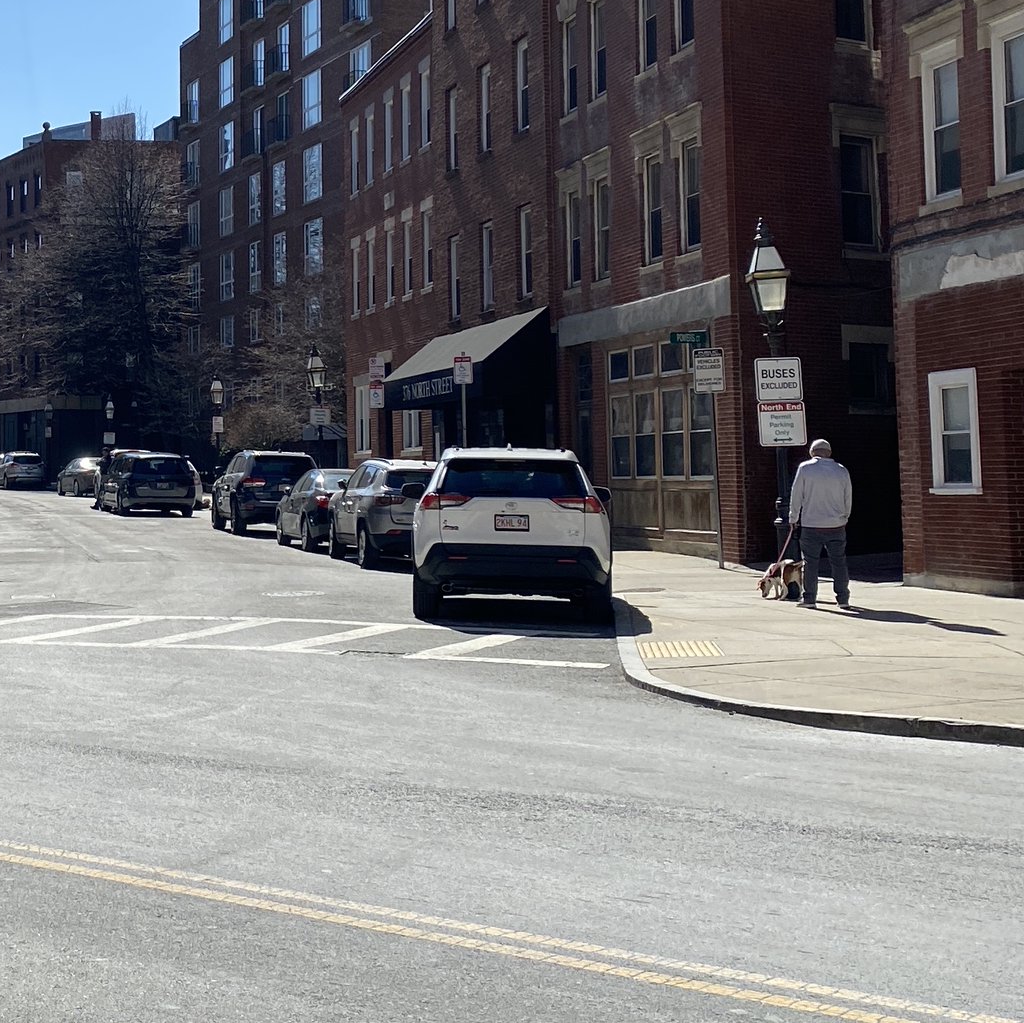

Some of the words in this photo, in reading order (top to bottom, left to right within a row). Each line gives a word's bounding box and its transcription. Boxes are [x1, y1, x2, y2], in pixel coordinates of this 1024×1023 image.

[761, 368, 796, 379] BUSES
[411, 380, 431, 400] NORTH
[431, 376, 453, 396] STREET
[761, 382, 798, 390] EXCLUDED
[761, 404, 784, 412] North
[786, 403, 802, 411] End
[769, 421, 794, 429] Parking
[774, 429, 790, 437] Only
